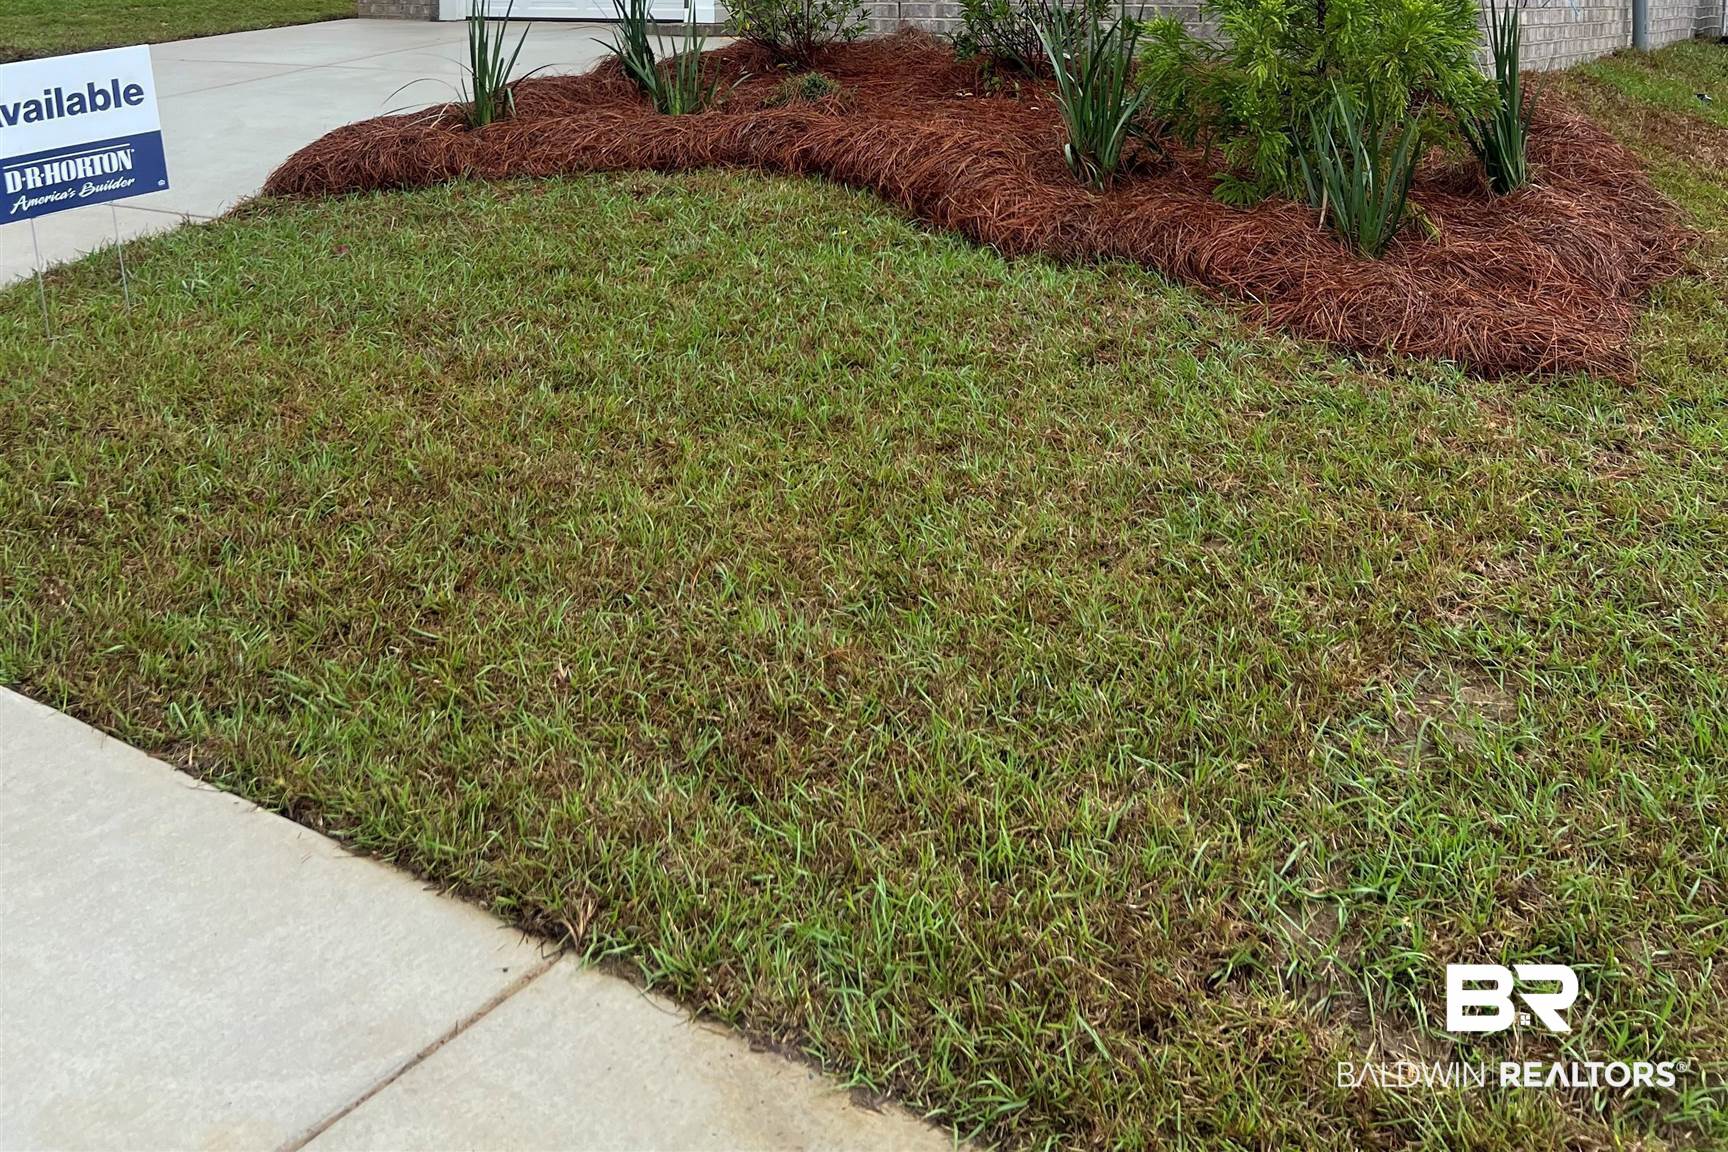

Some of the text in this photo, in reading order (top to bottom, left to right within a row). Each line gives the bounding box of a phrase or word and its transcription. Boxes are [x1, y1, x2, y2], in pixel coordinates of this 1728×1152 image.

[0, 78, 144, 127] vailable
[10, 177, 135, 215] America's Builder
